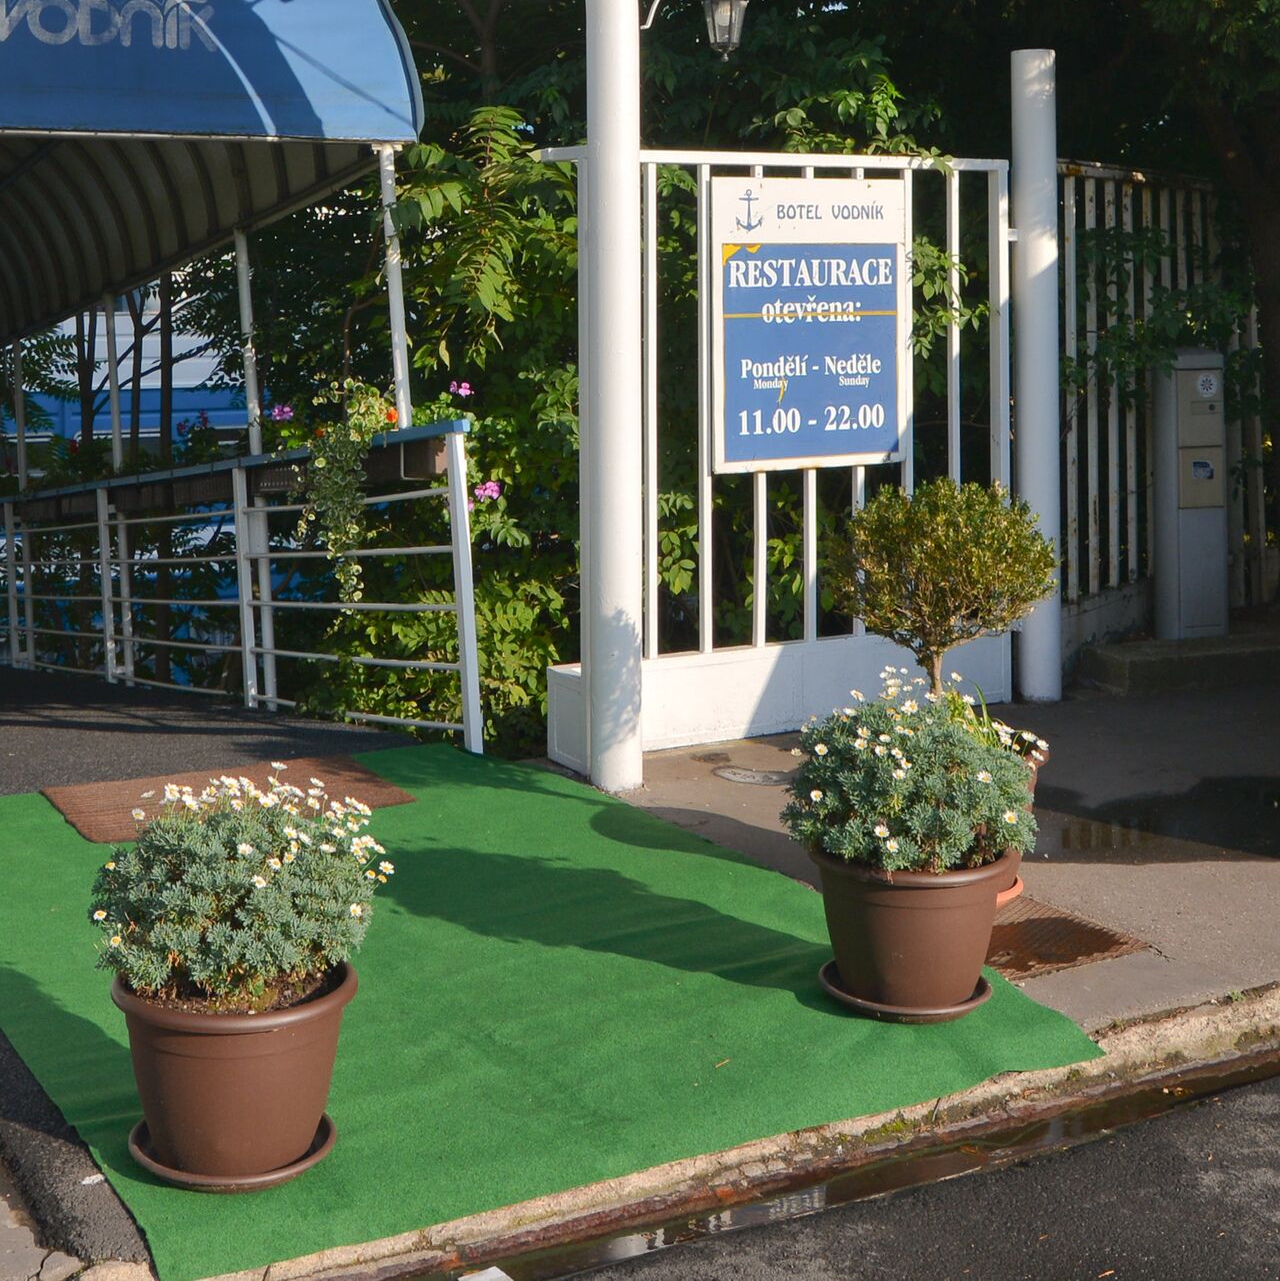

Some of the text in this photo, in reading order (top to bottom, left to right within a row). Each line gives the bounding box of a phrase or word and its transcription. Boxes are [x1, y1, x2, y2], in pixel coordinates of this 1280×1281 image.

[776, 200, 884, 220] BOTEL VODNÍK
[728, 258, 892, 288] RESTAURACE
[761, 295, 861, 324] otevřena:
[741, 354, 809, 379] Pondělí
[824, 353, 881, 376] Neděle
[753, 377, 788, 391] Monday
[838, 375, 870, 388] Sunday
[738, 407, 801, 436] 11.00
[824, 402, 885, 432] 22.00
